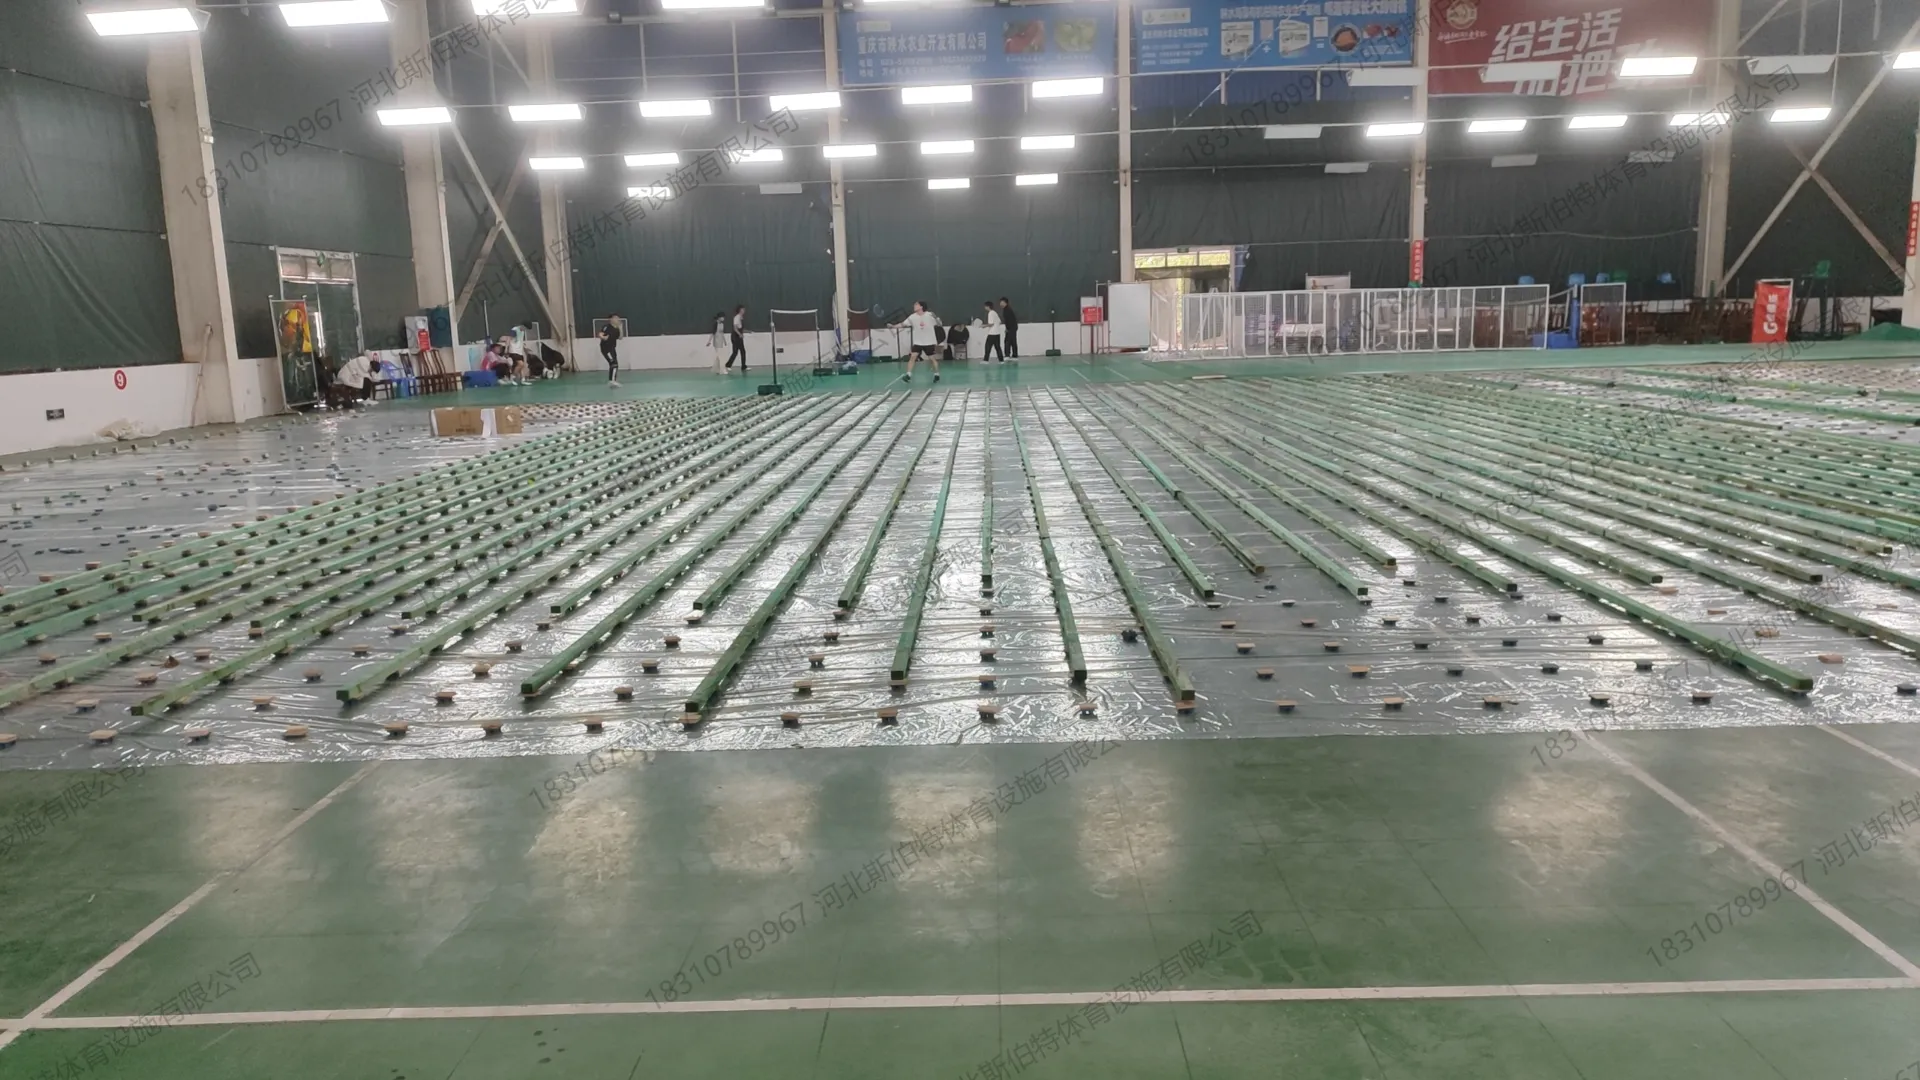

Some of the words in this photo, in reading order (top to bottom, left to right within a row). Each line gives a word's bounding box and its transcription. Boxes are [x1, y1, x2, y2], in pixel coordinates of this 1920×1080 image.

[1490, 8, 1622, 63] 给生活
[116, 374, 125, 387] 9
